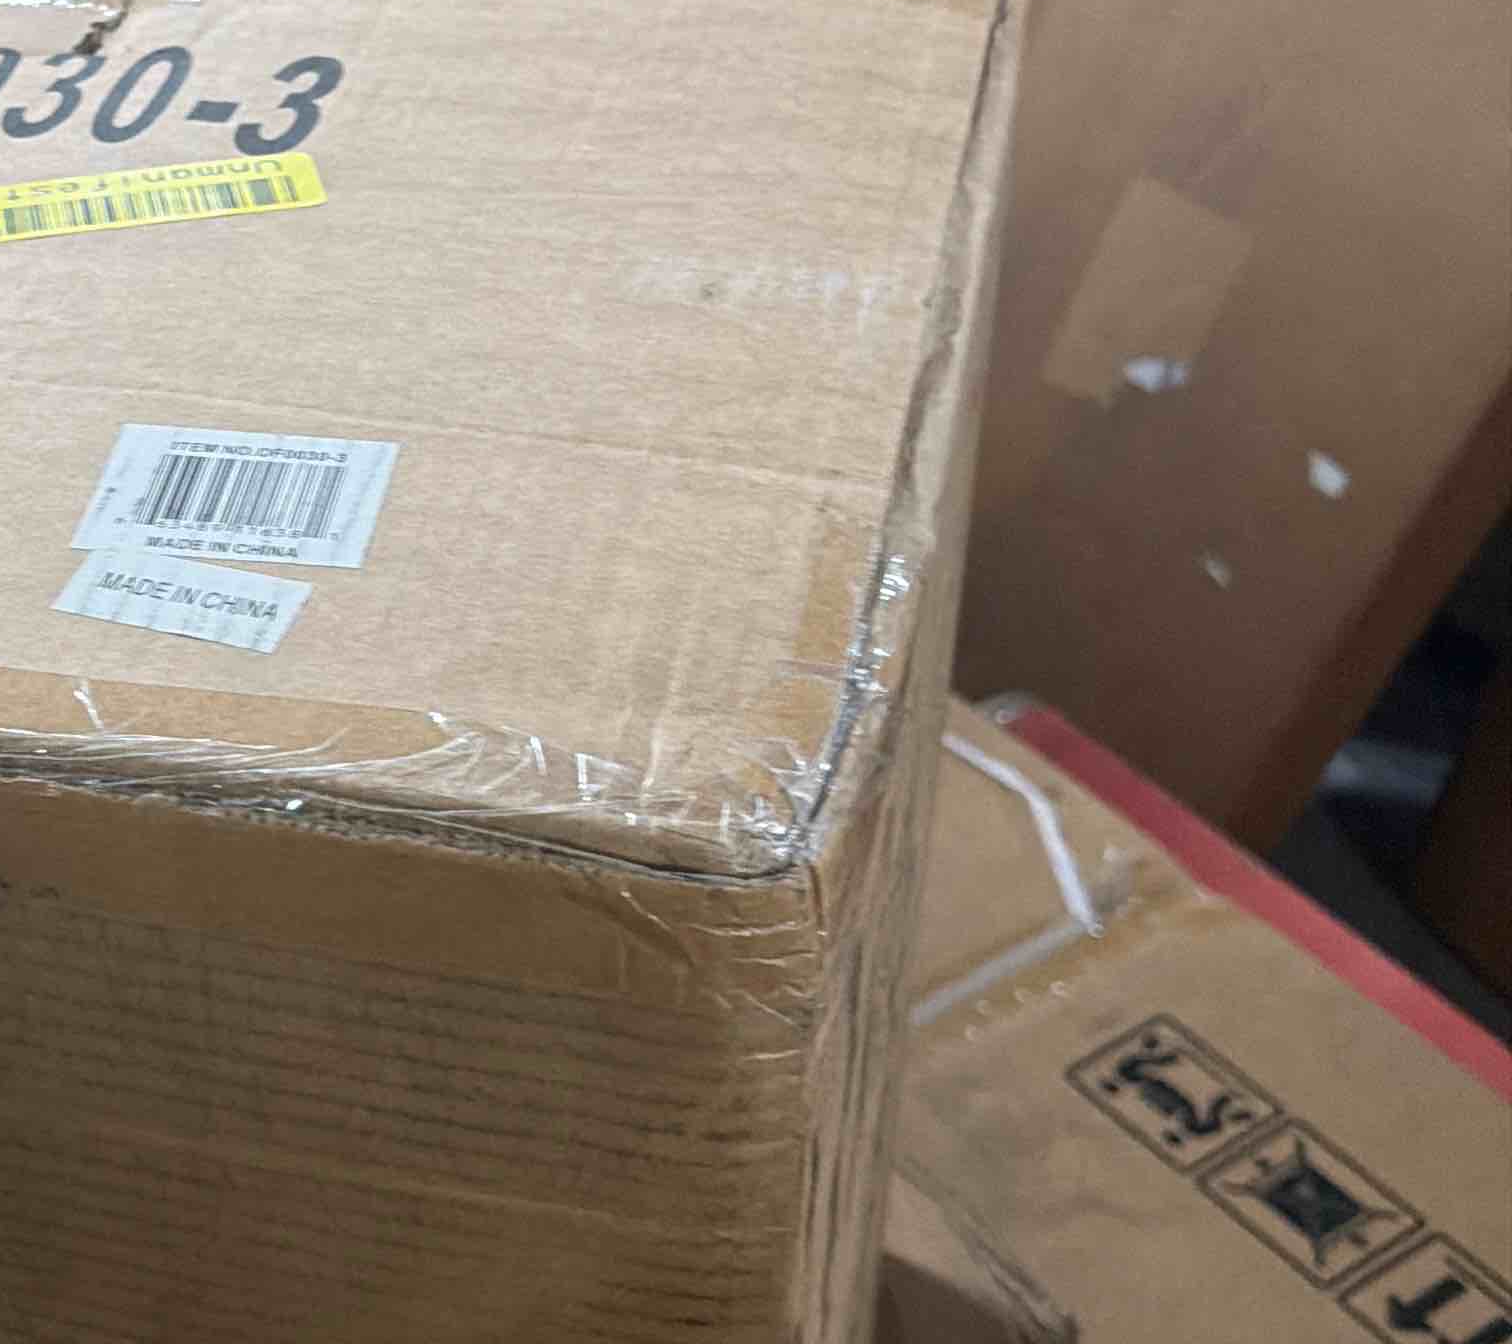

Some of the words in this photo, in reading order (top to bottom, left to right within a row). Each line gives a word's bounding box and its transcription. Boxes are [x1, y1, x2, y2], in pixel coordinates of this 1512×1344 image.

[145, 536, 200, 551] MADE
[207, 541, 229, 553] IN
[231, 543, 299, 558] CHINA
[97, 571, 173, 598] MADE
[172, 585, 202, 605] IN
[199, 591, 279, 618] CHINA
